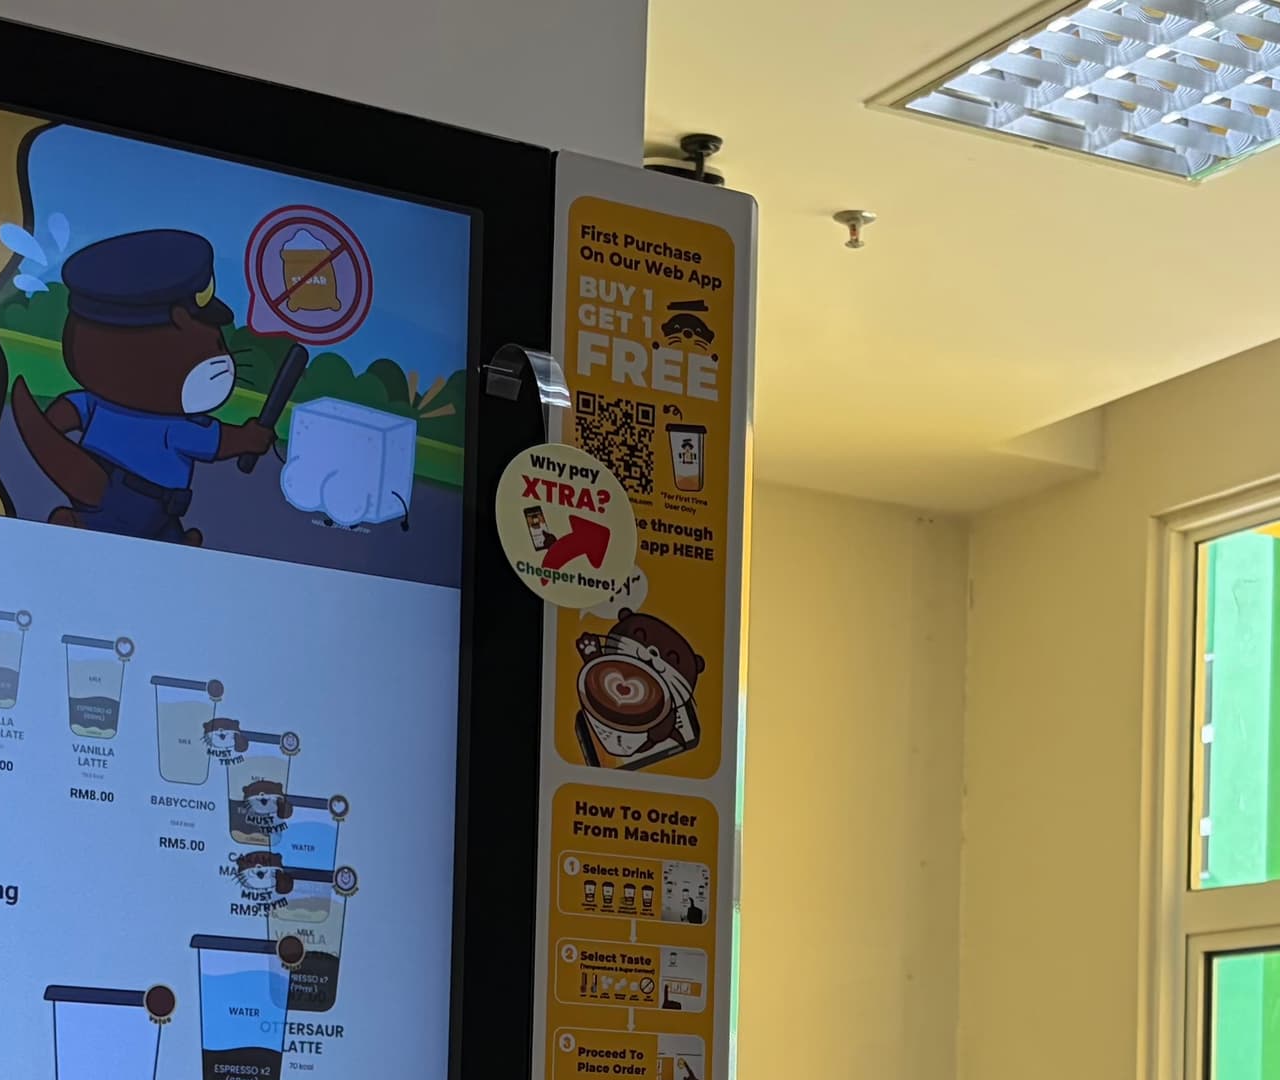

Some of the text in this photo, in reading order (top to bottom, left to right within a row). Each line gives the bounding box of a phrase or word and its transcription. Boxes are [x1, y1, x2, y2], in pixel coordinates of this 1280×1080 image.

[581, 224, 702, 264] First Purchase
[580, 246, 722, 291] On Our Web App
[579, 275, 653, 311] BUY 1
[578, 303, 653, 339] GET 1
[577, 329, 719, 402] FREE
[530, 453, 600, 484] Why pay
[521, 474, 611, 514] XTRA?
[650, 518, 713, 542] through
[640, 539, 714, 561] app HERE
[516, 560, 575, 584] Cheaper
[577, 573, 616, 592] here!
[72, 744, 114, 757] VANILLA
[78, 756, 108, 769] LATTE
[70, 787, 114, 802] RM8.00
[150, 795, 216, 811] BABYCCINO
[575, 800, 697, 828] How To Order
[573, 820, 698, 847] From Machine
[159, 836, 205, 852] RM5.00
[582, 863, 655, 881] Select Drink
[580, 950, 652, 966] Select Taste
[228, 1007, 260, 1017] WATER
[260, 1021, 344, 1038] OTTERSAUR
[282, 1040, 323, 1055] LATTE
[577, 1047, 644, 1060] Proceed To
[577, 1062, 647, 1075] Place Order
